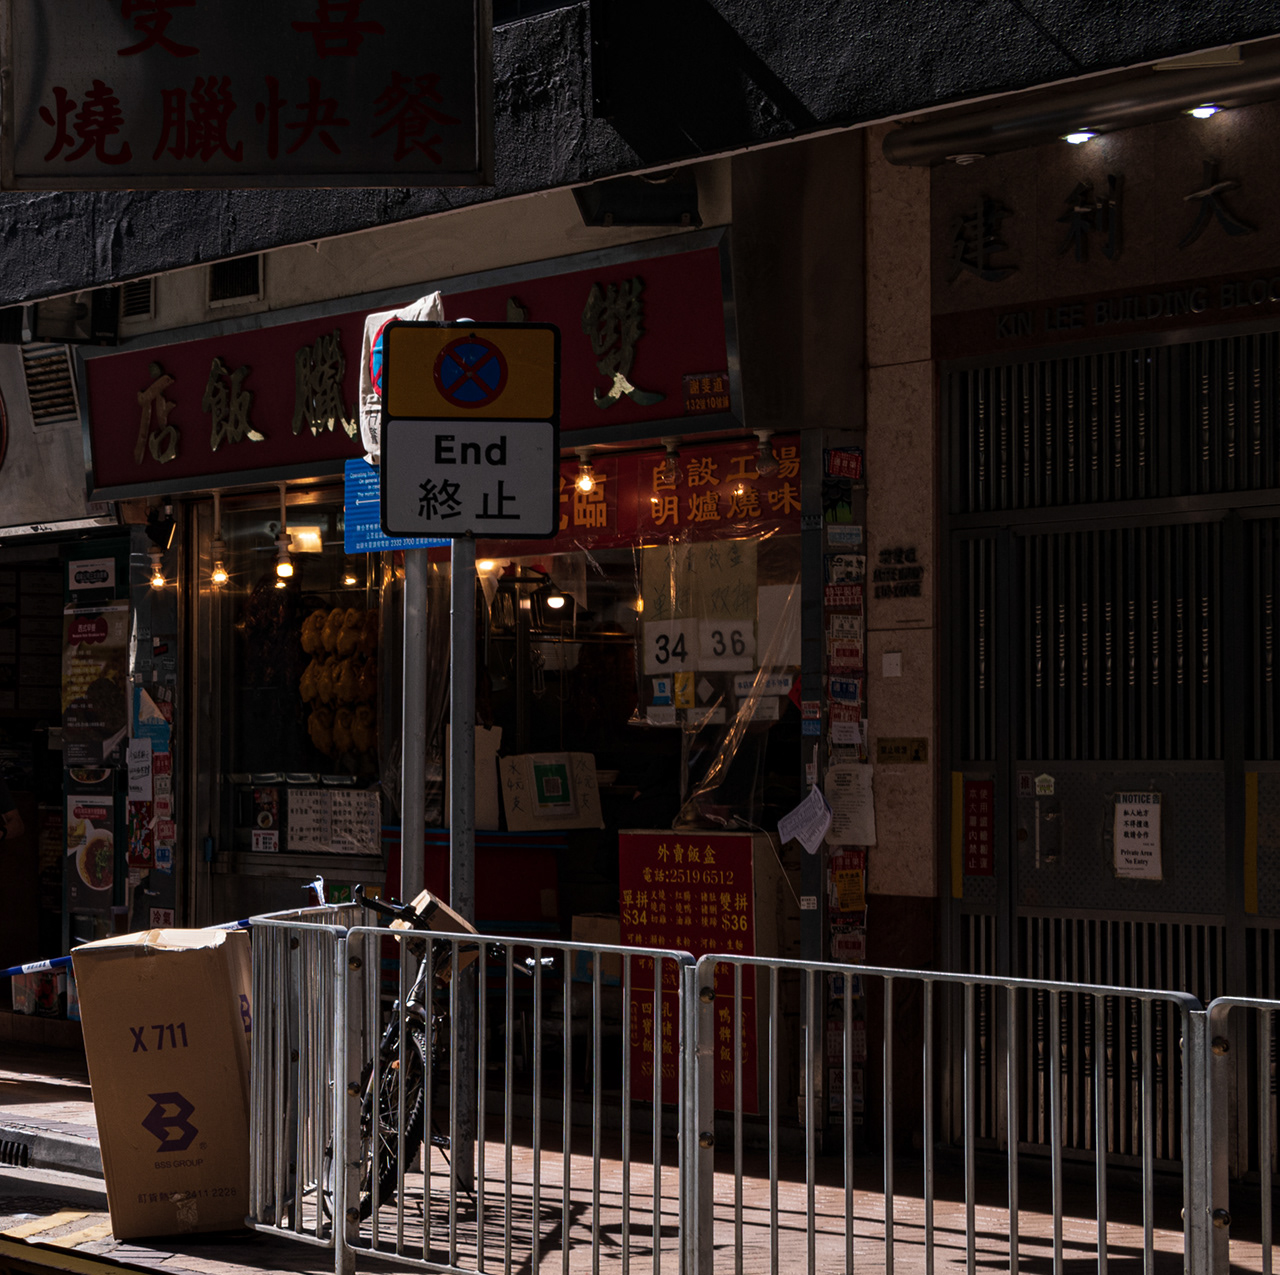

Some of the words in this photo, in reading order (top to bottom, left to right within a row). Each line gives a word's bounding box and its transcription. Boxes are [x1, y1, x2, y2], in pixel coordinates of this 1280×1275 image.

[39, 70, 463, 167] 燒臘快餐
[996, 311, 1032, 340] KIN
[1044, 304, 1085, 331] LEE
[1094, 287, 1209, 326] BUILDING
[434, 434, 507, 466] End
[418, 478, 521, 521] 終止
[655, 633, 688, 664] 34
[711, 630, 746, 656] 36
[1122, 794, 1152, 804] NOTICE
[657, 843, 716, 865] 外賣飯盒
[702, 870, 734, 886] 6512
[622, 909, 648, 927] $34
[721, 915, 748, 932] $36
[129, 1026, 148, 1053] X
[150, 1022, 189, 1051] 711
[154, 1160, 172, 1170] BSS
[173, 1158, 204, 1169] GROUP
